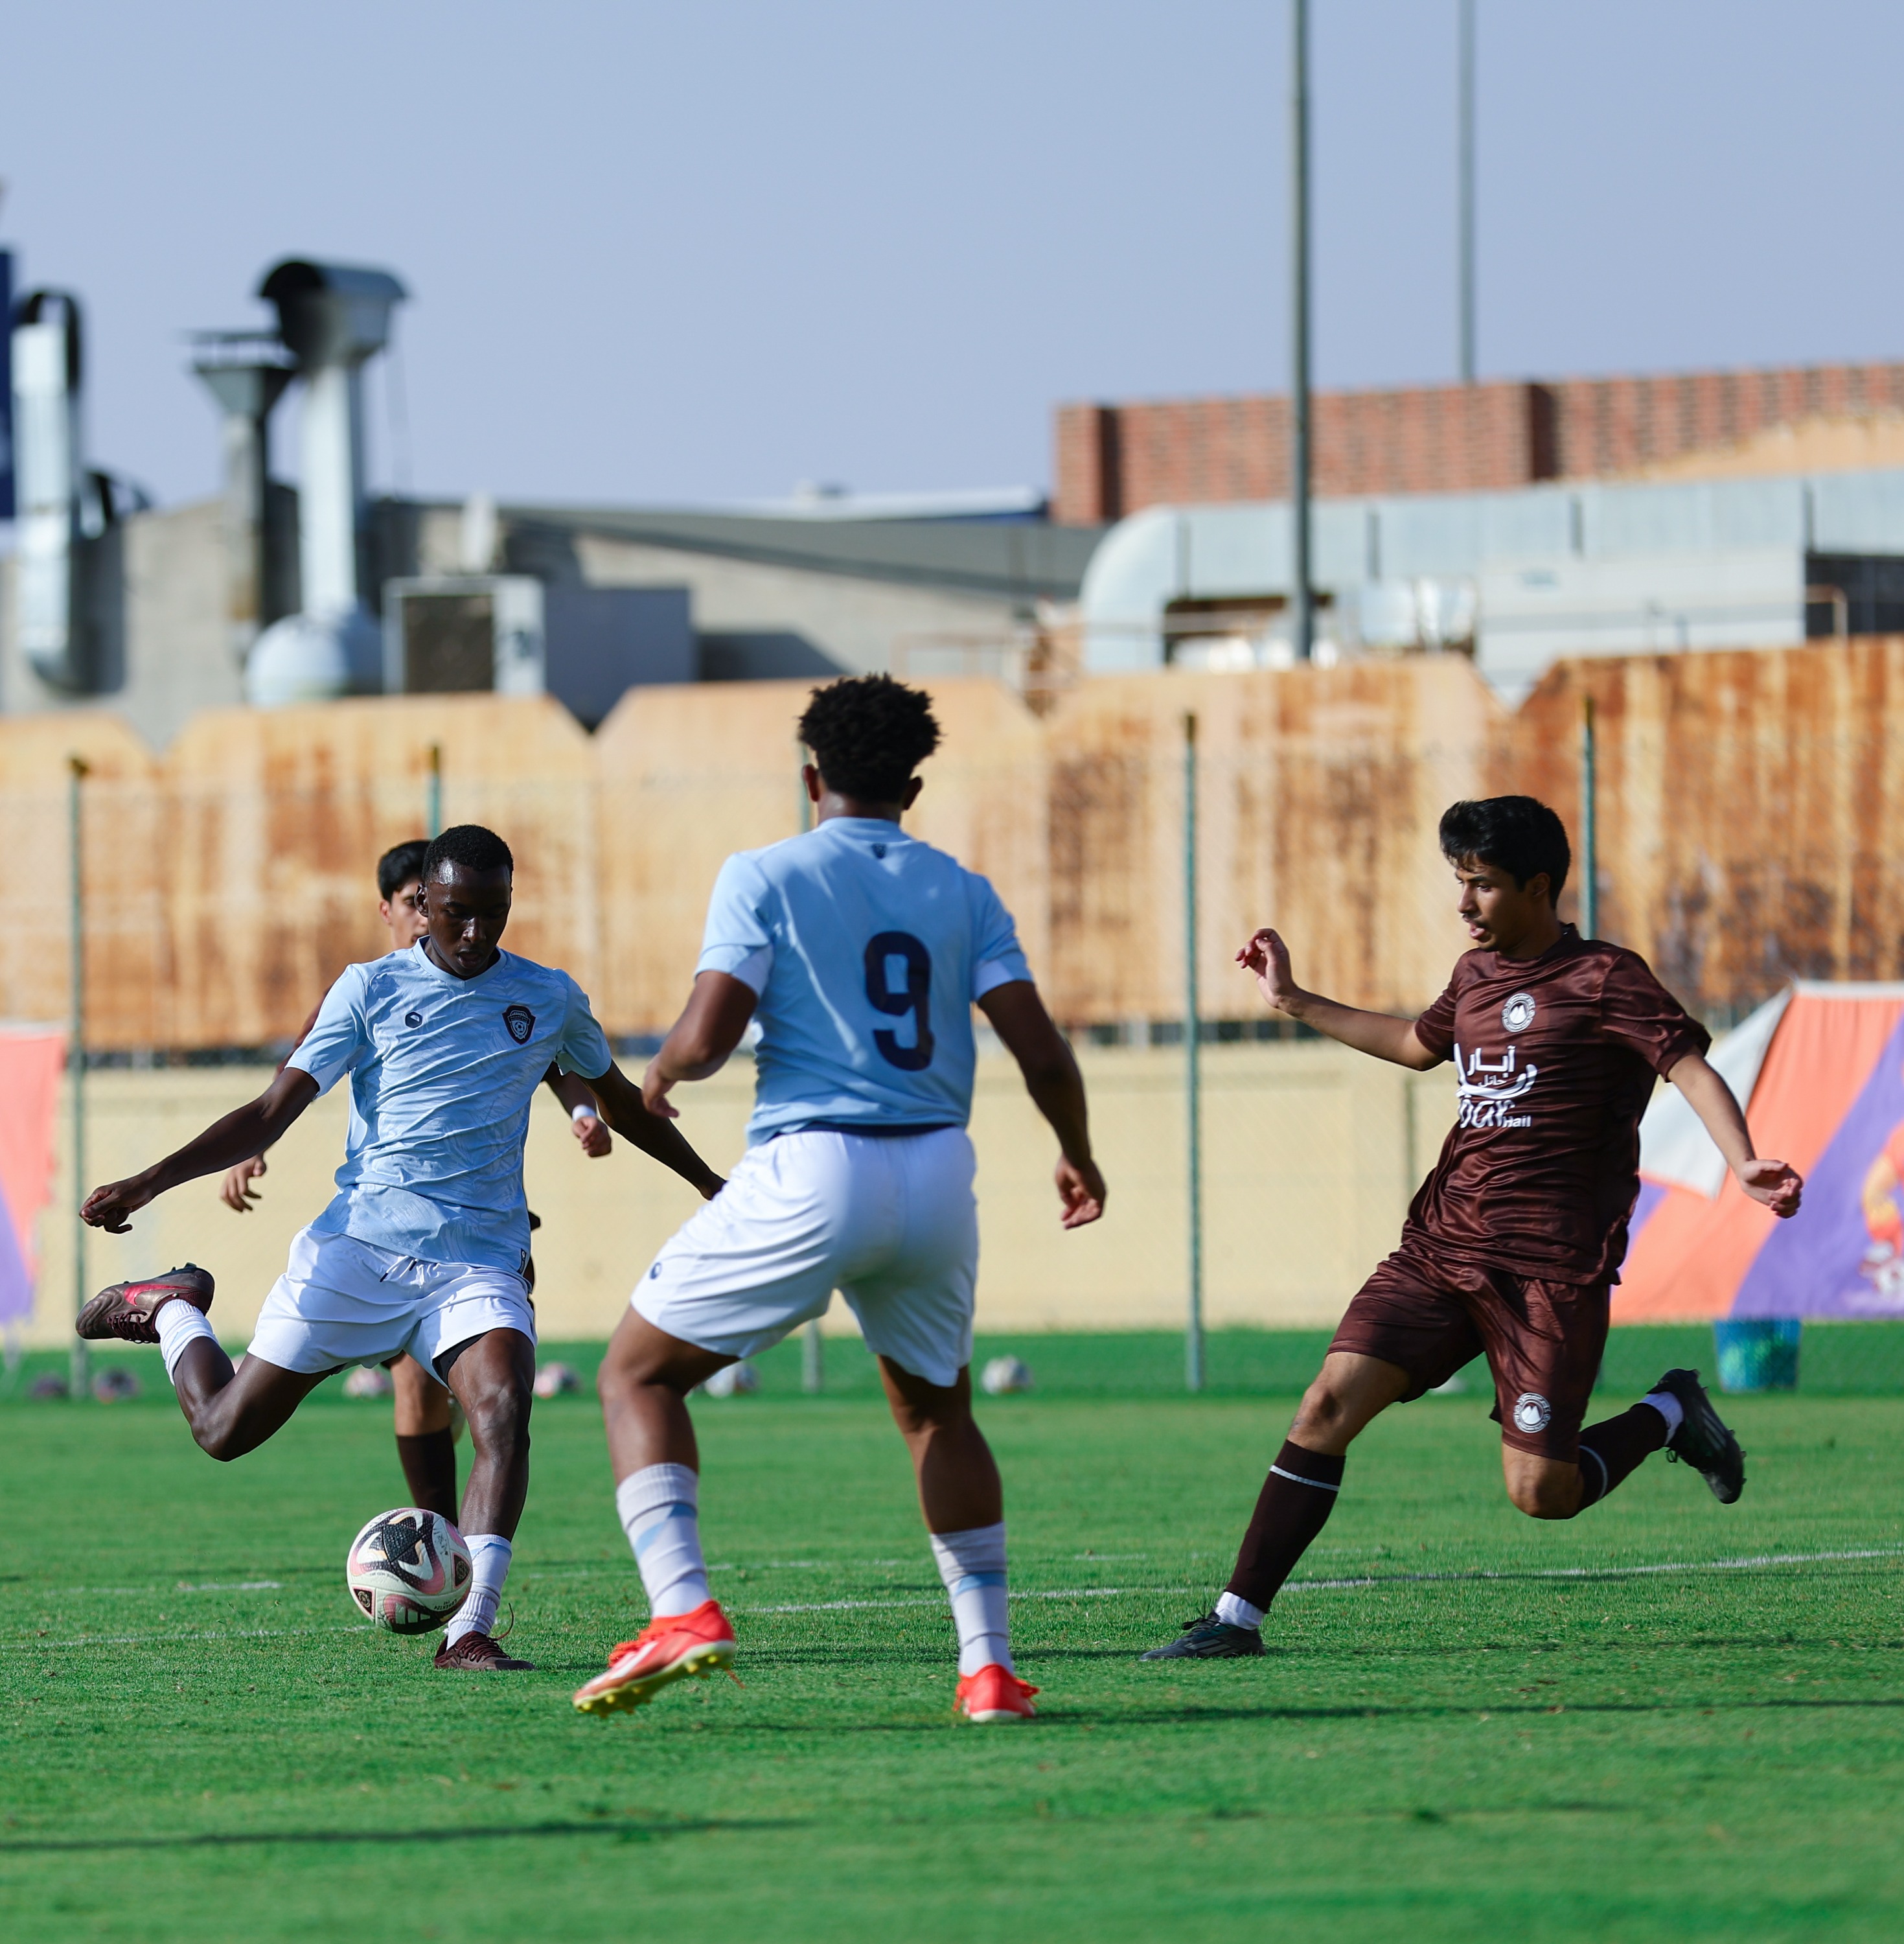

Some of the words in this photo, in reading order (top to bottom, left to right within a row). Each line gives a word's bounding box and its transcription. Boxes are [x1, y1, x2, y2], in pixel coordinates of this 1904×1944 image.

[864, 930, 935, 1071] 9
[1467, 1045, 1516, 1078] آبار
[1478, 1074, 1507, 1087] حائل
[1502, 1115, 1531, 1128] Hail
